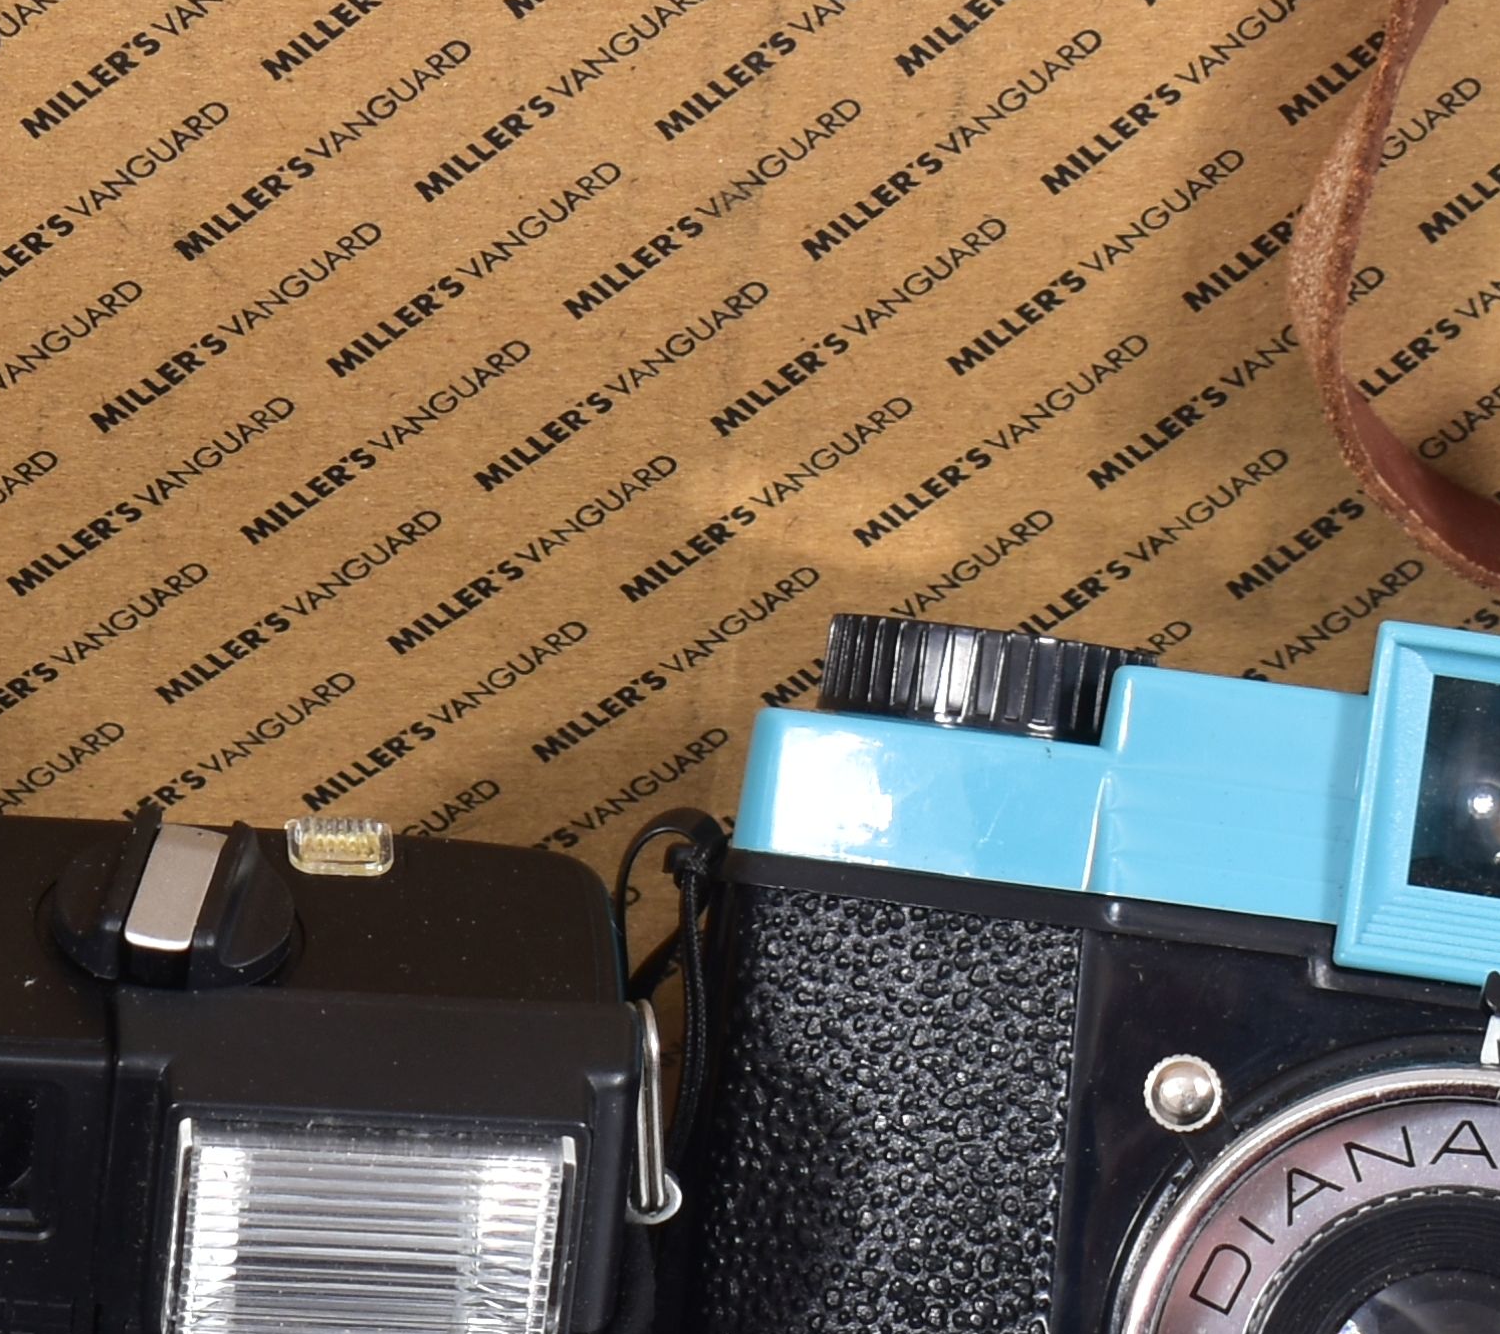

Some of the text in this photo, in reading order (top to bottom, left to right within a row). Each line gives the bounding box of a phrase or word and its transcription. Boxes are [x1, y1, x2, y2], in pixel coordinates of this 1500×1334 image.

[20, 31, 161, 140] MILLER'S
[801, 29, 1102, 262] MILLER'S VANGUARD
[1040, 83, 1182, 196] MILLER'S
[325, 162, 622, 378] MILLER'S VANGUARD
[562, 99, 861, 320] MILLER'S VANGUARD
[945, 149, 1245, 377] MILLER'S VANGUARD
[89, 222, 382, 434] MILLER'S VANGUARD
[5, 397, 295, 597] MILLER'S VANGUARD
[619, 397, 913, 603] MILLER'S VANGUARD
[853, 335, 1149, 548] MILLER'S VANGUARD
[49, 563, 209, 665] VANGUARD
[386, 455, 677, 656] MILLER'S VANGUARD
[301, 621, 588, 812] MILLER'S VANGUARD
[531, 567, 820, 764] MILLER'S VANGUARD
[1187, 1118, 1500, 1317] DIANA
